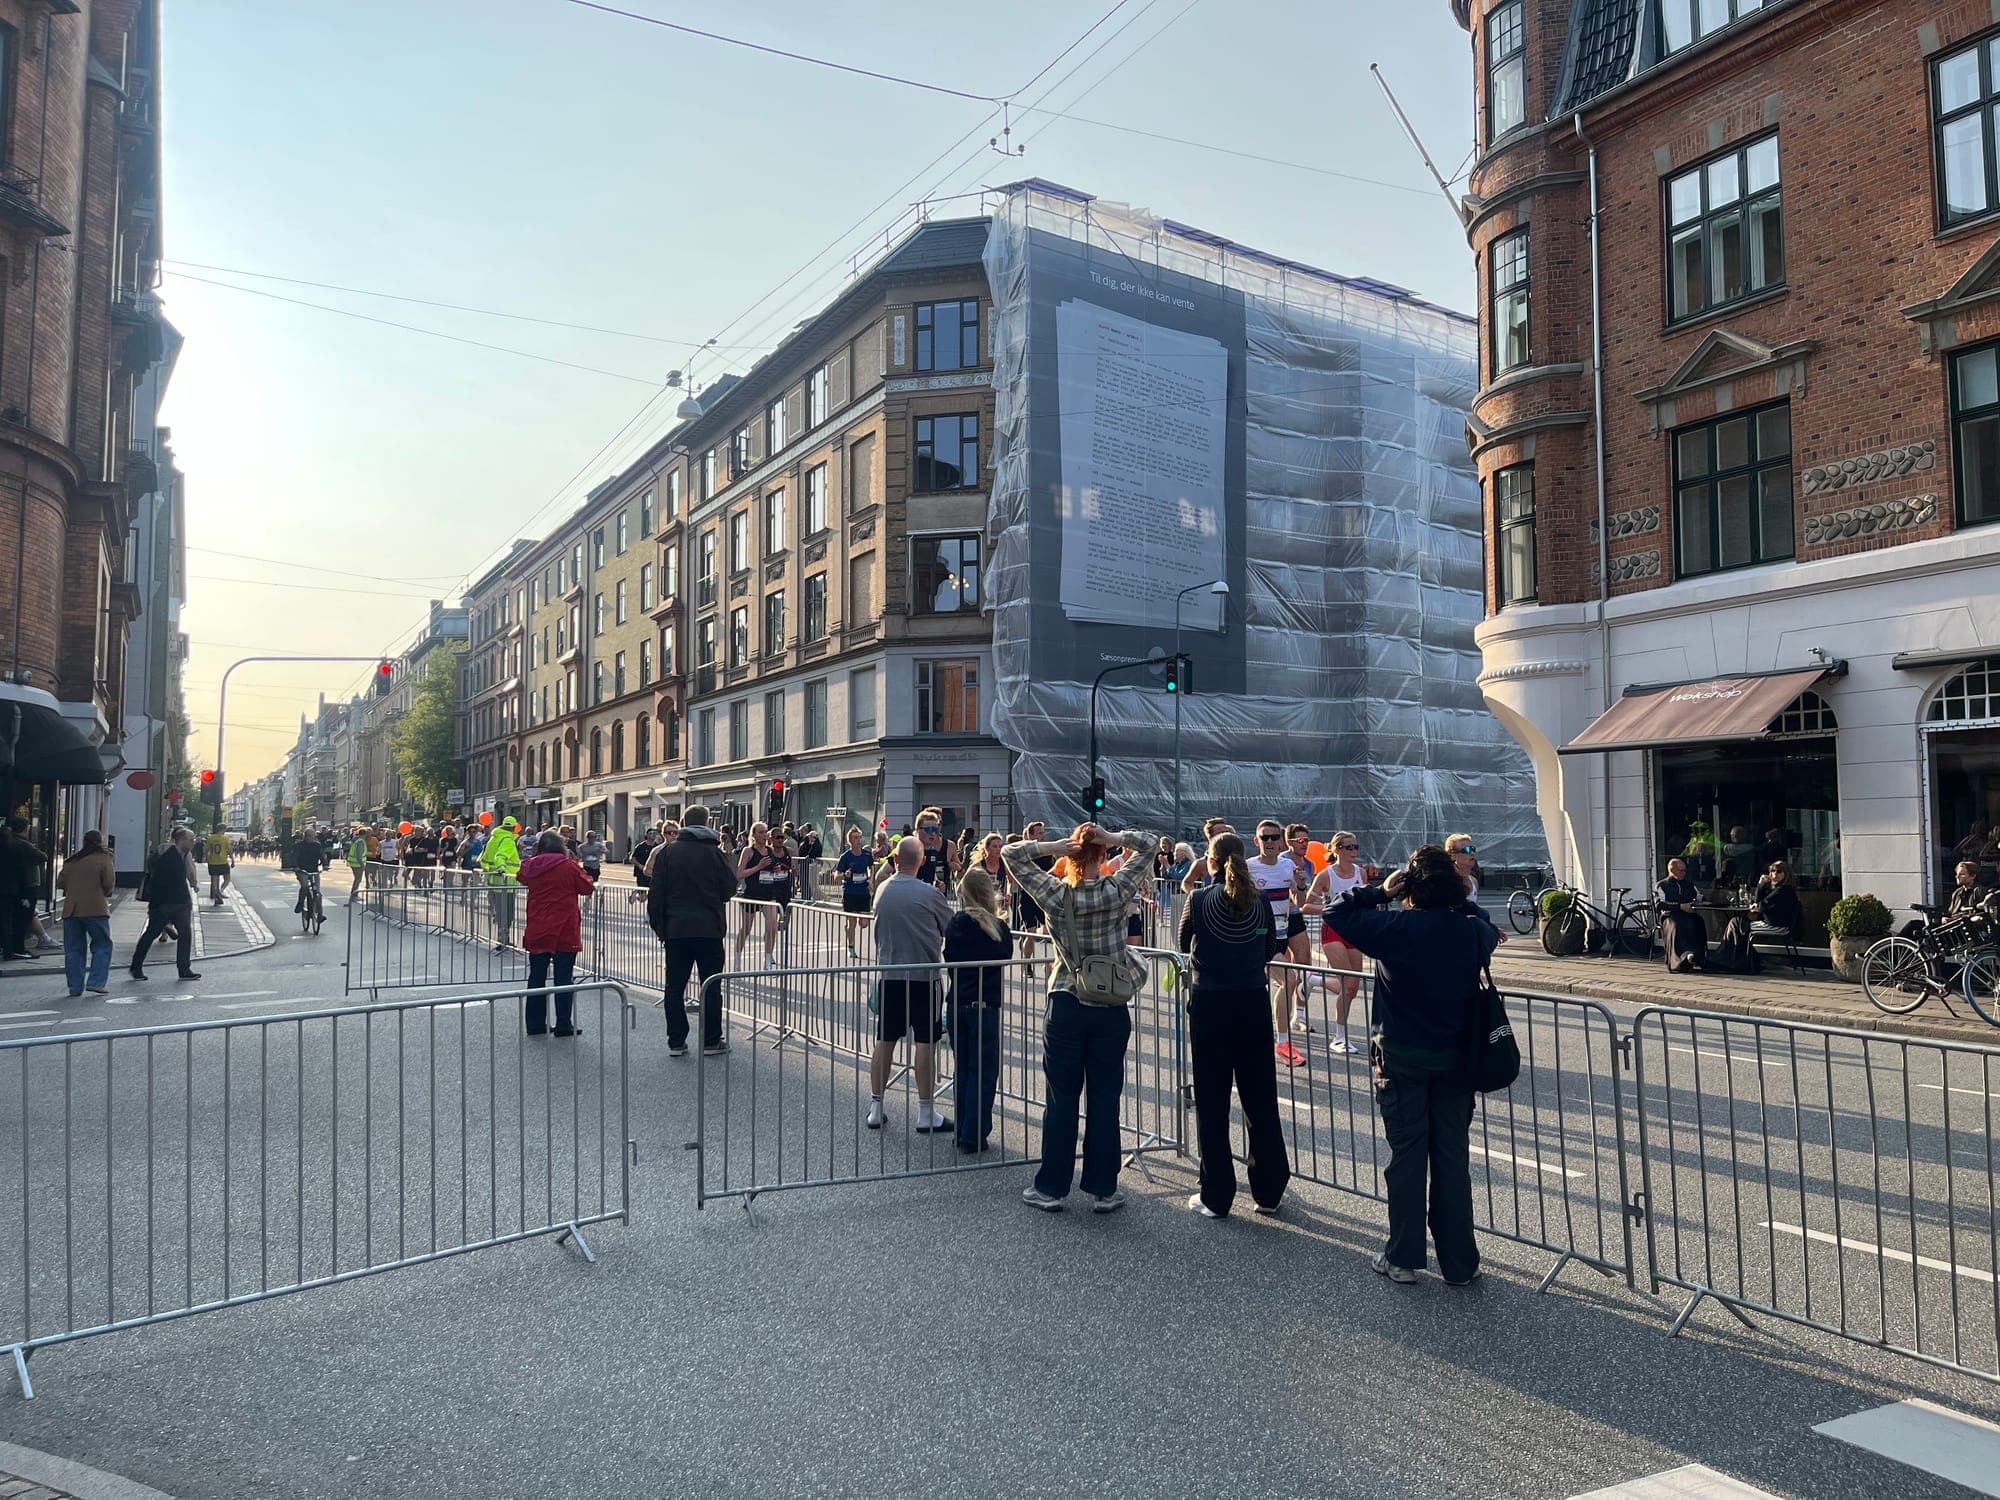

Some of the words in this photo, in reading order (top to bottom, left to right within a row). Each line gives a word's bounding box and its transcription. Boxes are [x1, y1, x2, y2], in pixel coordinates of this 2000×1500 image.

[1089, 270, 1100, 283] Til
[1102, 275, 1118, 291] dig,
[1120, 280, 1136, 293] der
[1138, 284, 1154, 298] ikke
[1156, 289, 1171, 303] kan
[1172, 296, 1195, 311] vente
[1100, 652, 1148, 664] Sæsonprem
